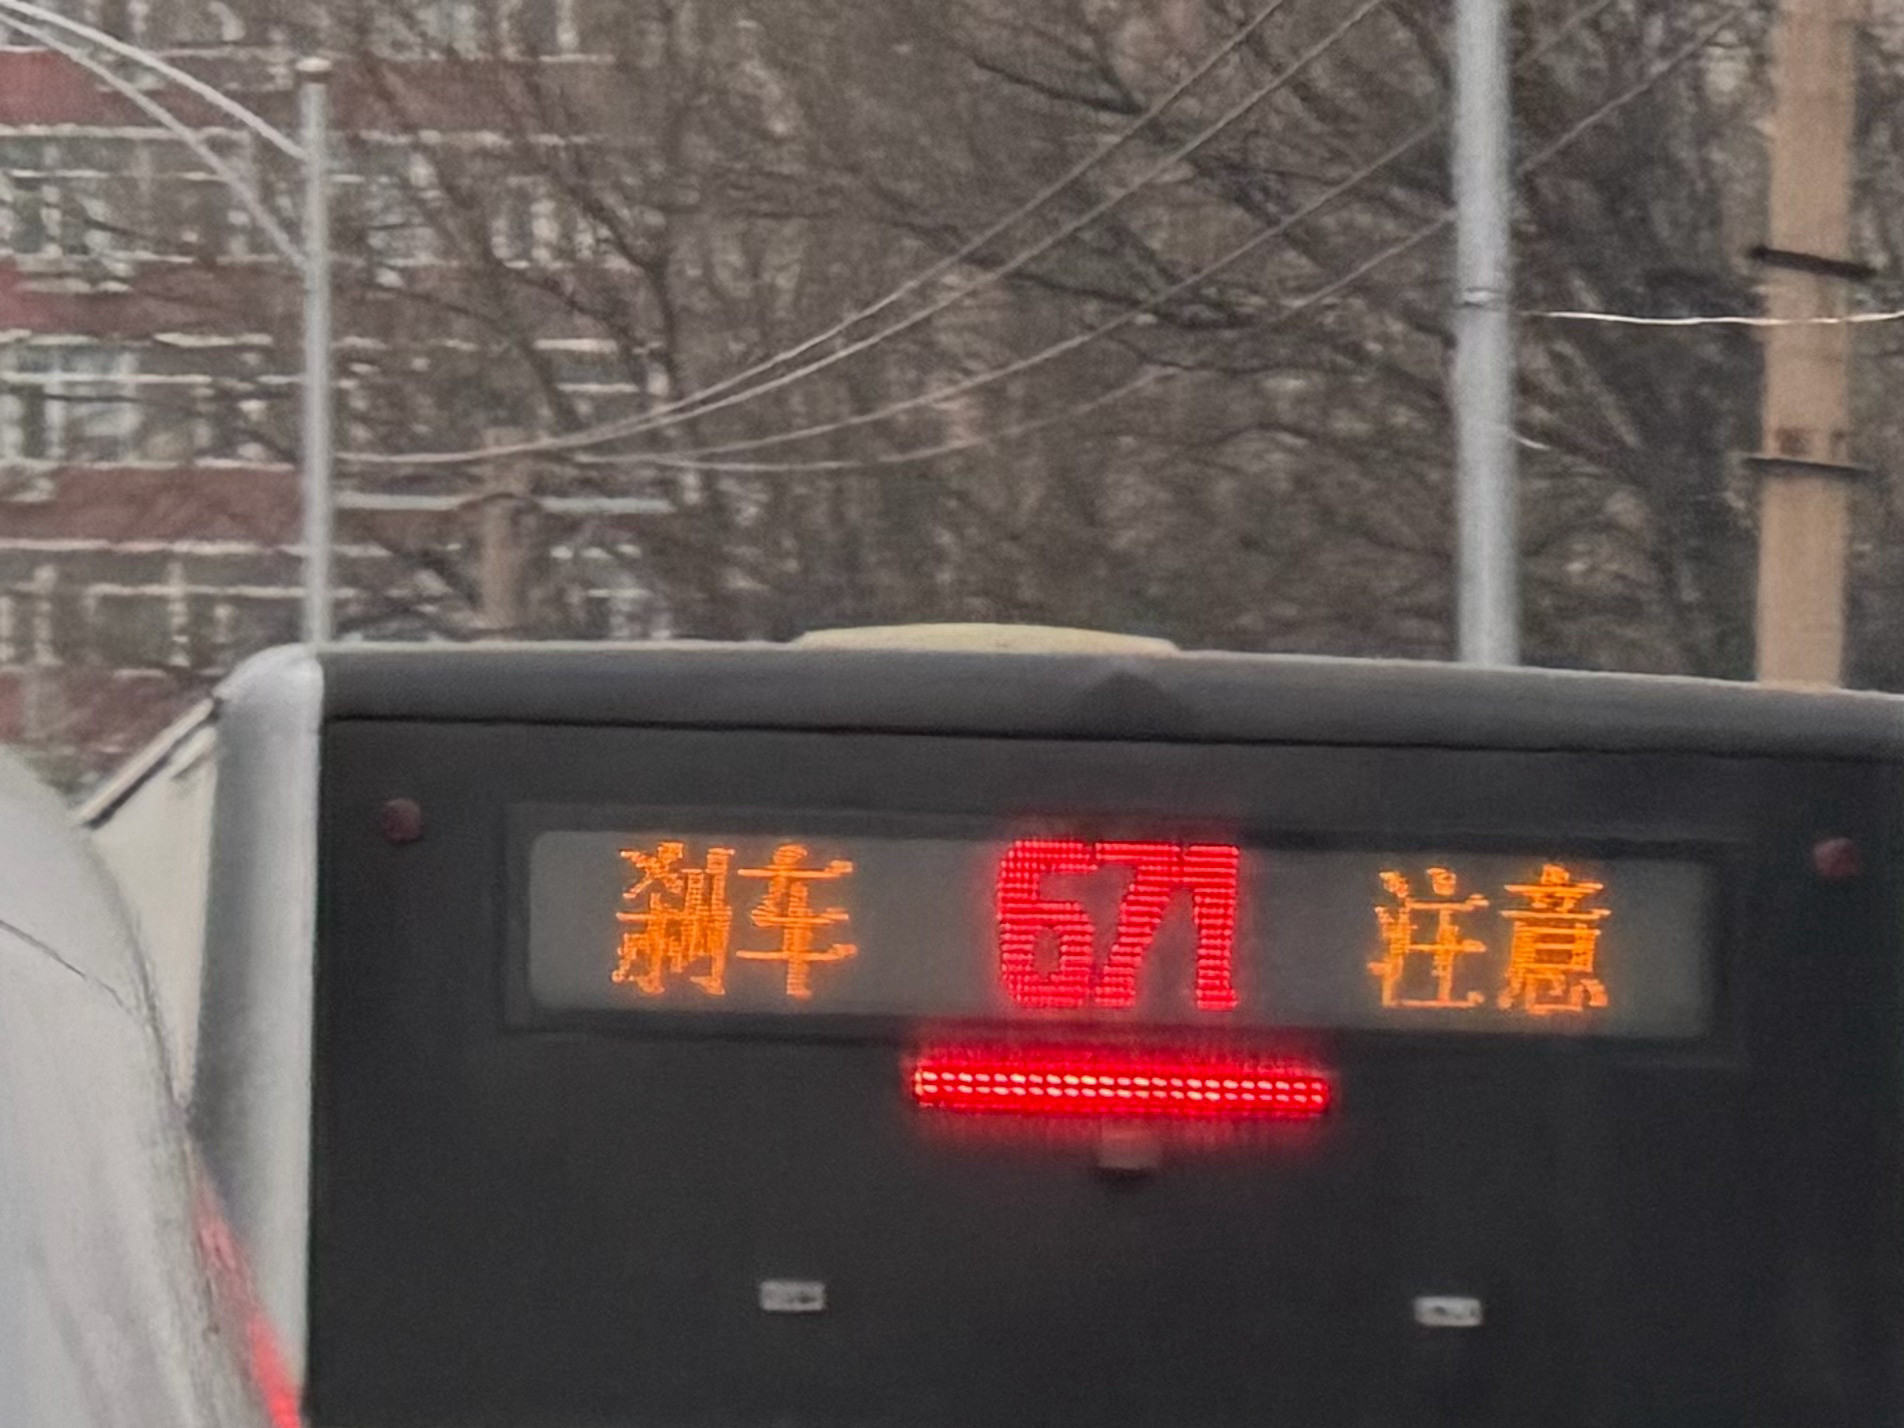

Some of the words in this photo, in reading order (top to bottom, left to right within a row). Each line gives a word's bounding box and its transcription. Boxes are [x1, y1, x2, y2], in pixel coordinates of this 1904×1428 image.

[611, 839, 859, 998] 刹车
[996, 836, 1241, 1012] 671
[1367, 861, 1610, 1015] 注意
